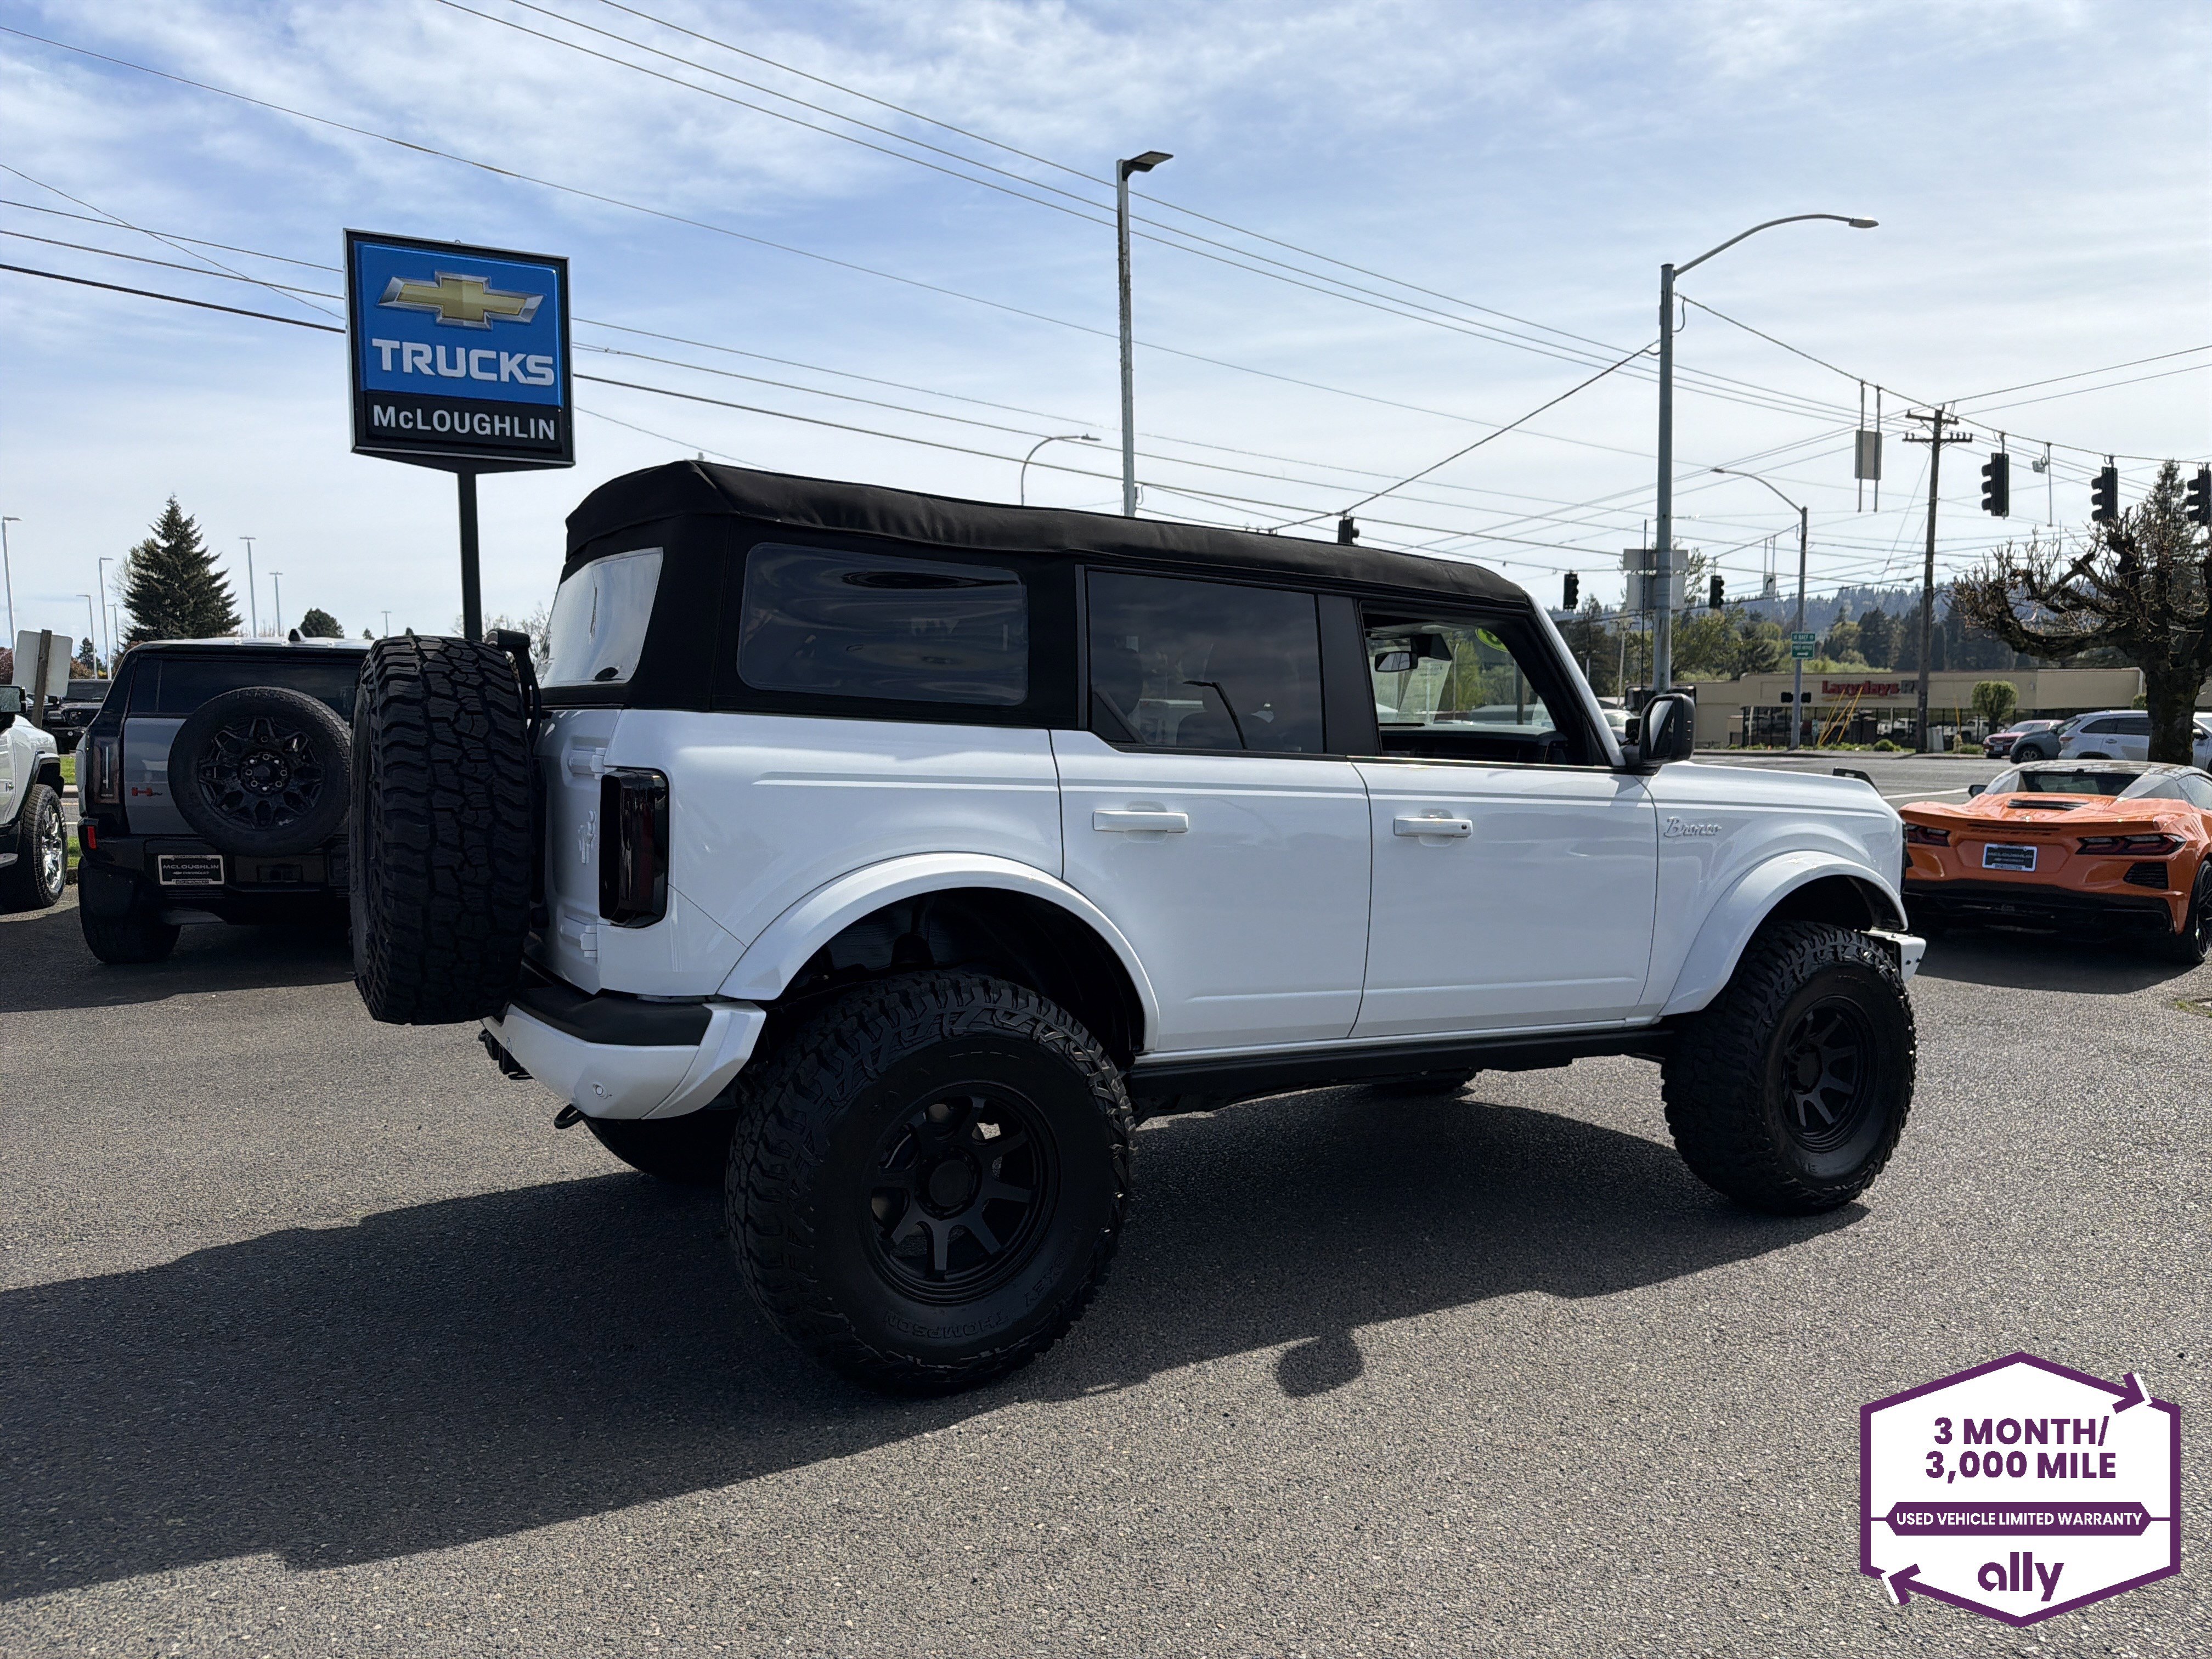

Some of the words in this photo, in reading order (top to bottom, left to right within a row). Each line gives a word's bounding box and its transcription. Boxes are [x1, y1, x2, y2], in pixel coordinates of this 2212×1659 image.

[372, 338, 555, 386] TRUCKS
[373, 404, 555, 441] McLOUGHLIN
[1822, 680, 1900, 697] Lazydays
[1664, 816, 1722, 838] Bronco
[883, 1311, 1008, 1339] THOMPSON
